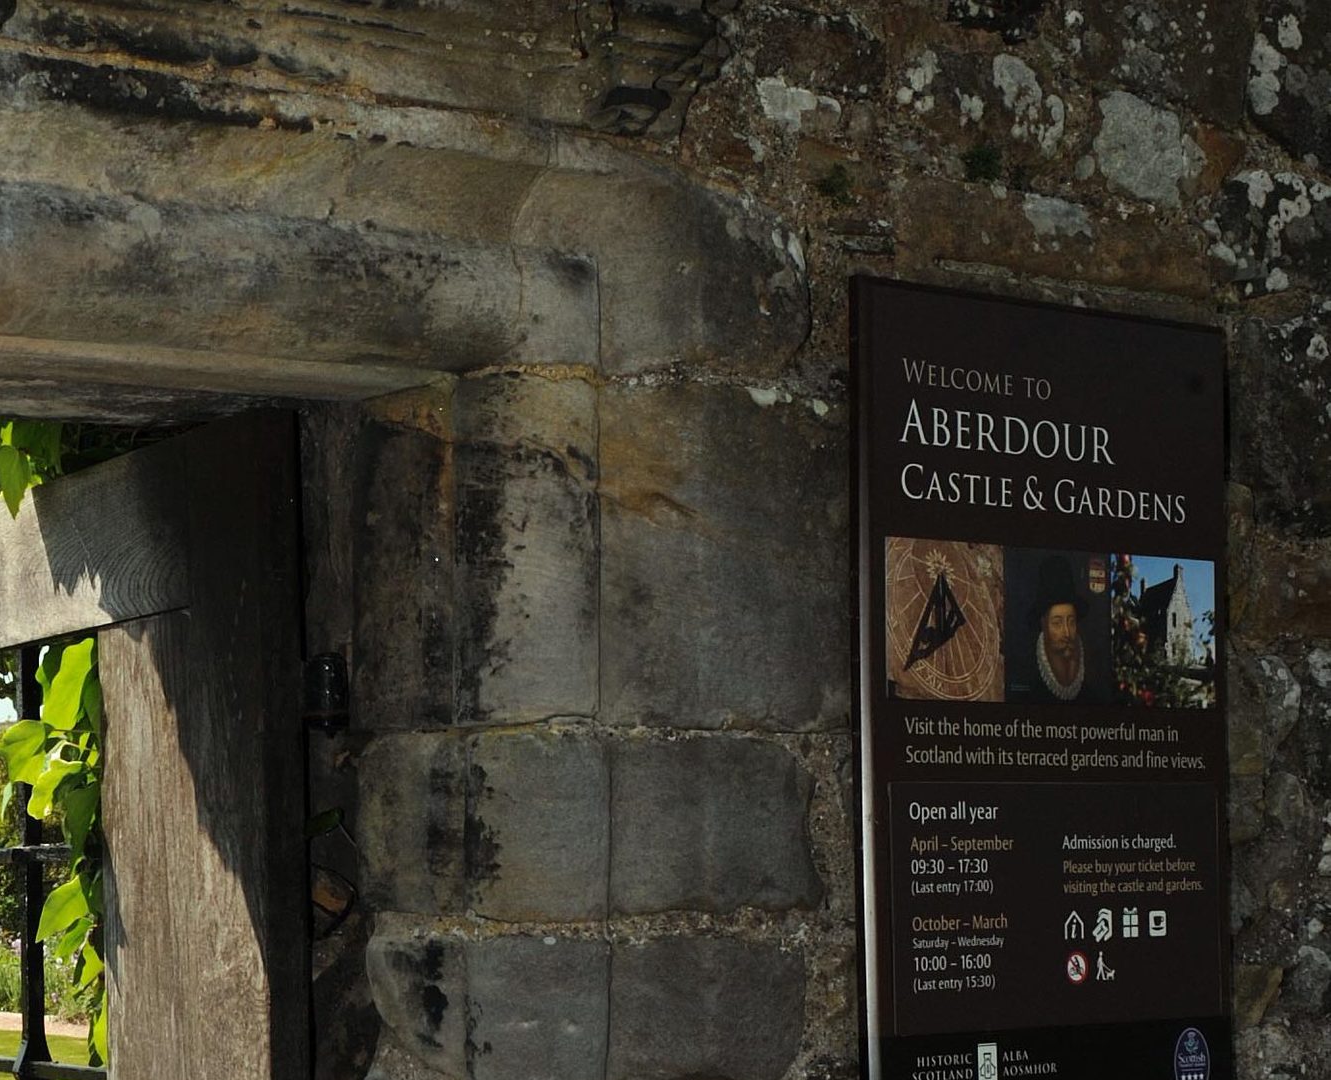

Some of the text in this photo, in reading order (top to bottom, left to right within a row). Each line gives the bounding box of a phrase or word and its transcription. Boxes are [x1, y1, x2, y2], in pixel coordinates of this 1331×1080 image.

[902, 358, 1052, 400] WELCOME TO
[899, 398, 1115, 465] ABERDOUR
[901, 463, 1186, 524] CASTLE & GARDENS
[905, 717, 1179, 745] Visit the home of the most powerful man in
[906, 745, 1206, 772] Scotland with its terraced gardens and fine views.
[909, 801, 998, 825] Open all year
[910, 835, 939, 856] April
[950, 835, 1014, 855] September
[1062, 834, 1176, 853] Admission is charged.
[911, 859, 945, 875] 09:30
[958, 859, 988, 874] 17:30
[1063, 858, 1195, 876] Please buy your ticket before
[911, 880, 994, 897] (Last entry 17:00)
[1063, 877, 1203, 897] visiting the castle and gardens.
[912, 915, 960, 932] October
[972, 913, 1008, 930] March
[912, 937, 949, 951] Saturday
[957, 935, 1004, 949] Wednesday
[914, 956, 947, 972] 10:00
[960, 954, 991, 970] 16:00
[913, 975, 996, 994] (Last entry 15:30)
[916, 1053, 973, 1068] HISTORIC
[1002, 1050, 1029, 1062] ALBA
[1002, 1061, 1058, 1076] AOSMHOR
